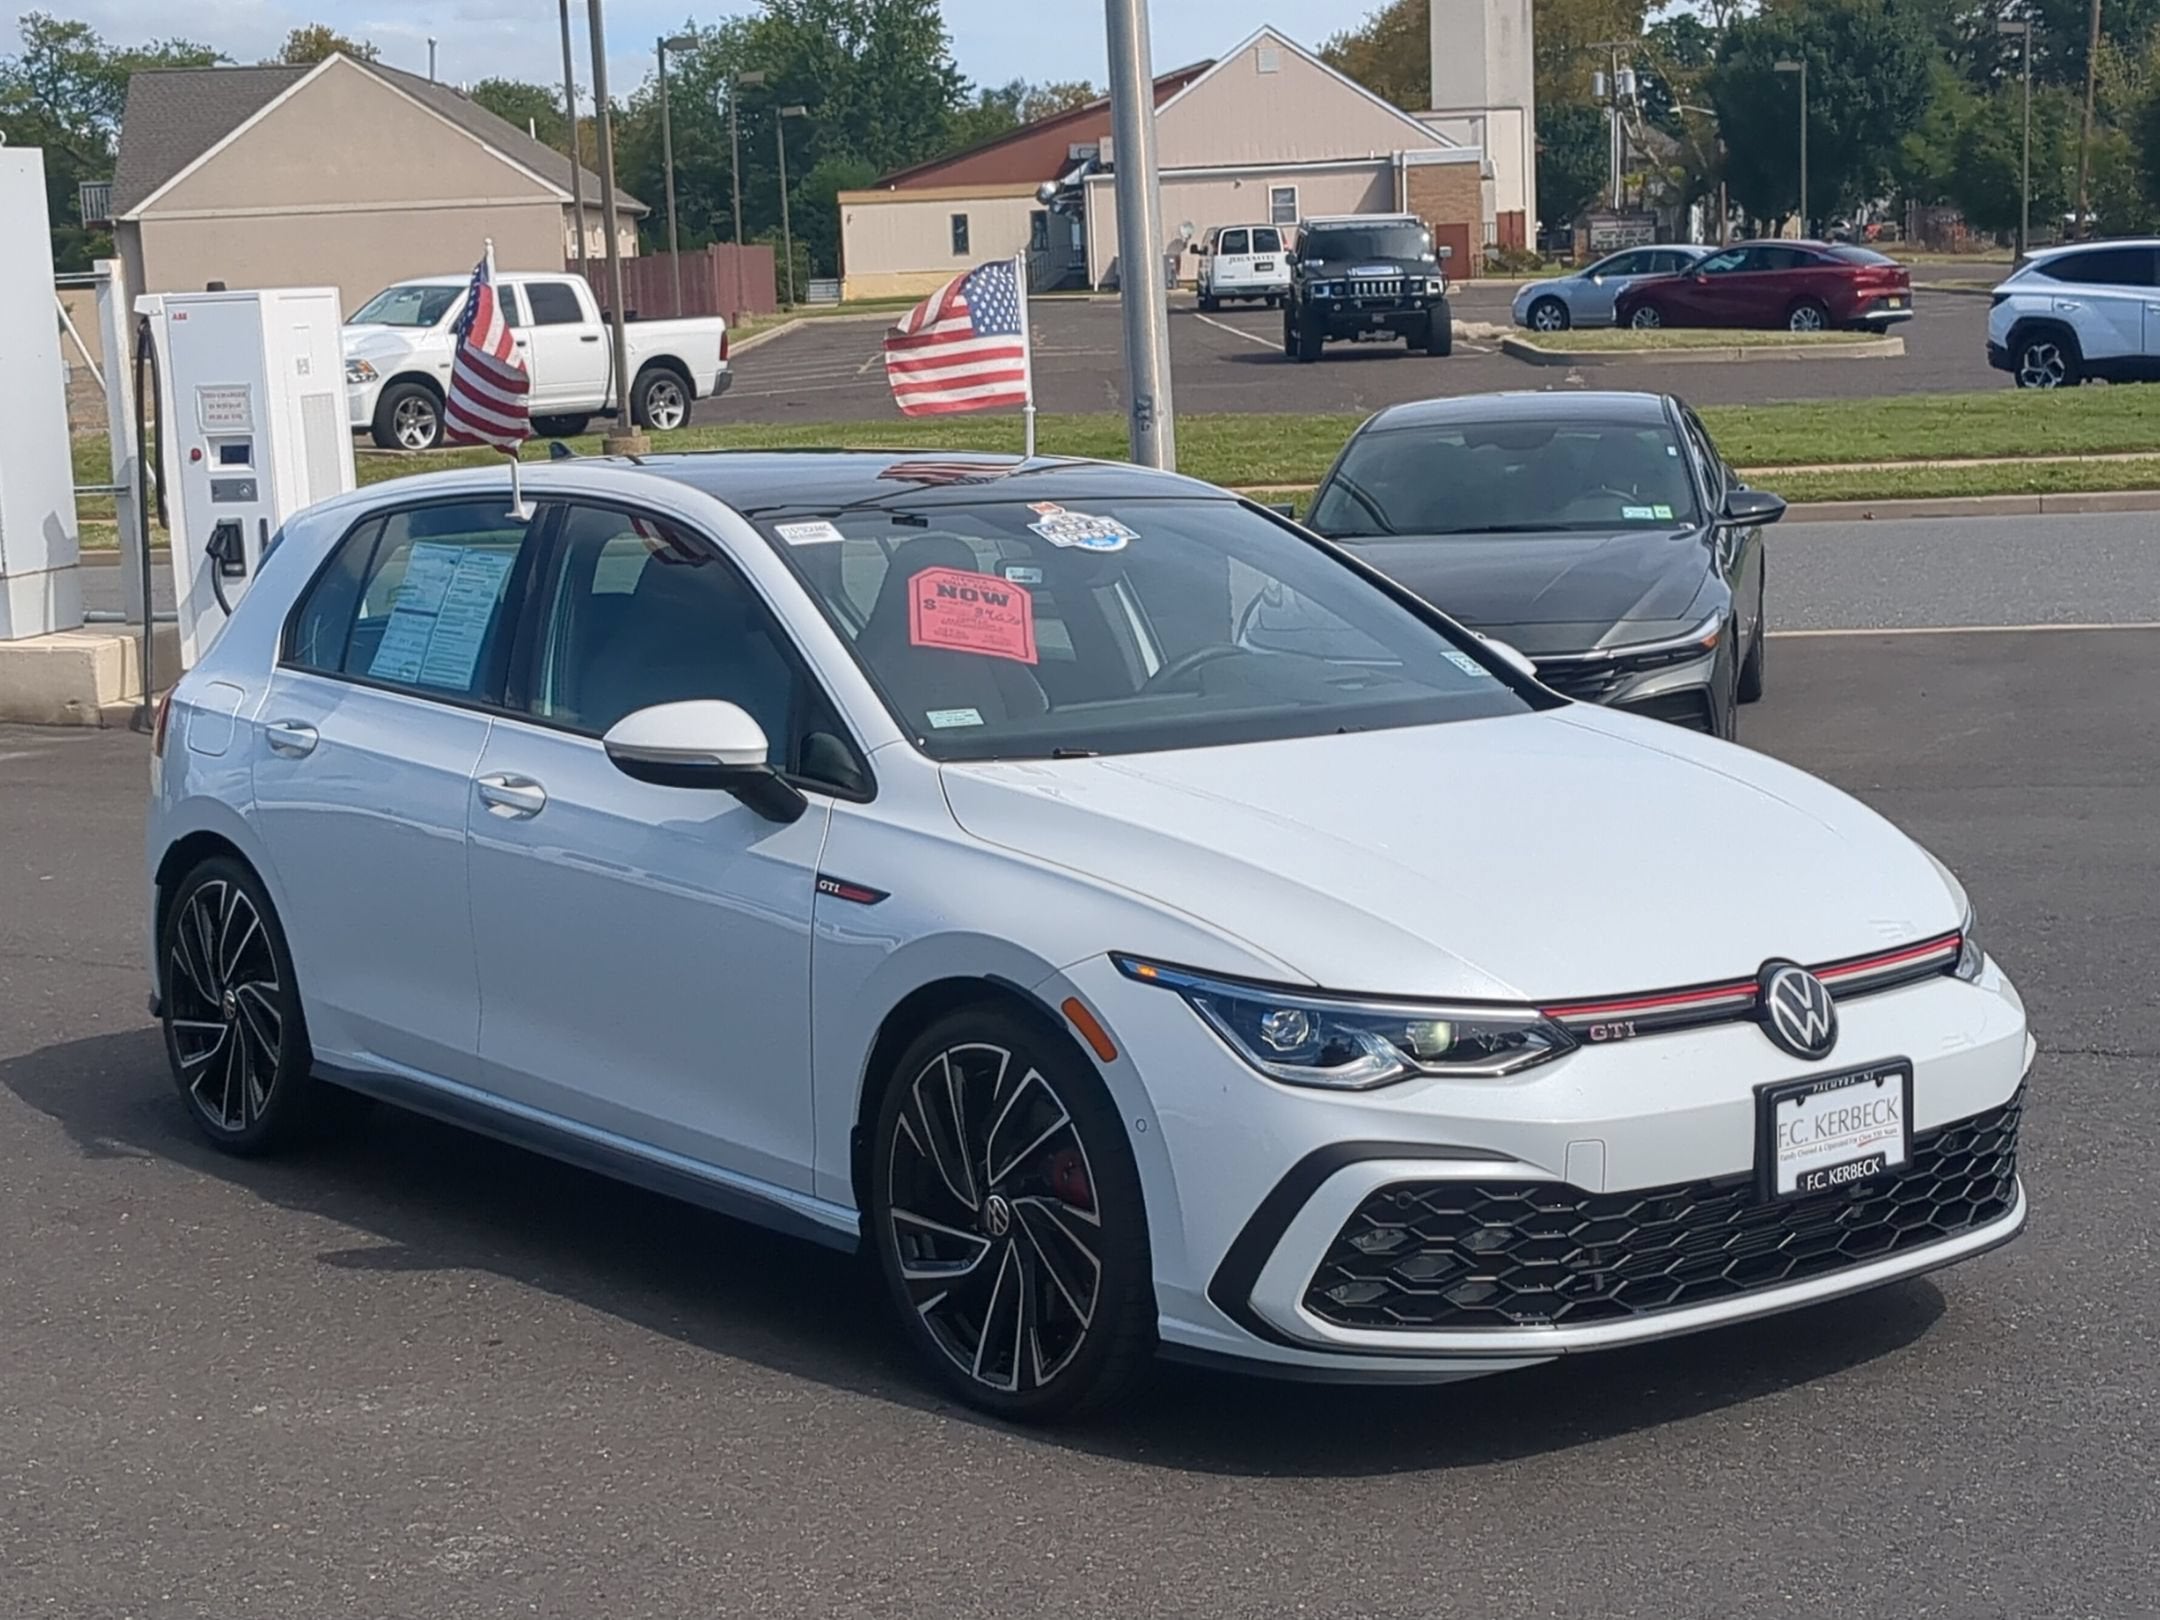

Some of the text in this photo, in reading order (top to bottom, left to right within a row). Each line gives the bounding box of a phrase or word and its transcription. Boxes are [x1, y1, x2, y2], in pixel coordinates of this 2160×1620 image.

[936, 583, 1009, 607] NOW
[819, 880, 840, 893] GTI
[1589, 1021, 1636, 1041] GTI
[1813, 1076, 1855, 1092] PALMYRA
[1778, 1095, 1898, 1148] F.C. KERBECK
[1807, 1157, 1880, 1191] F.C. KERBECK
